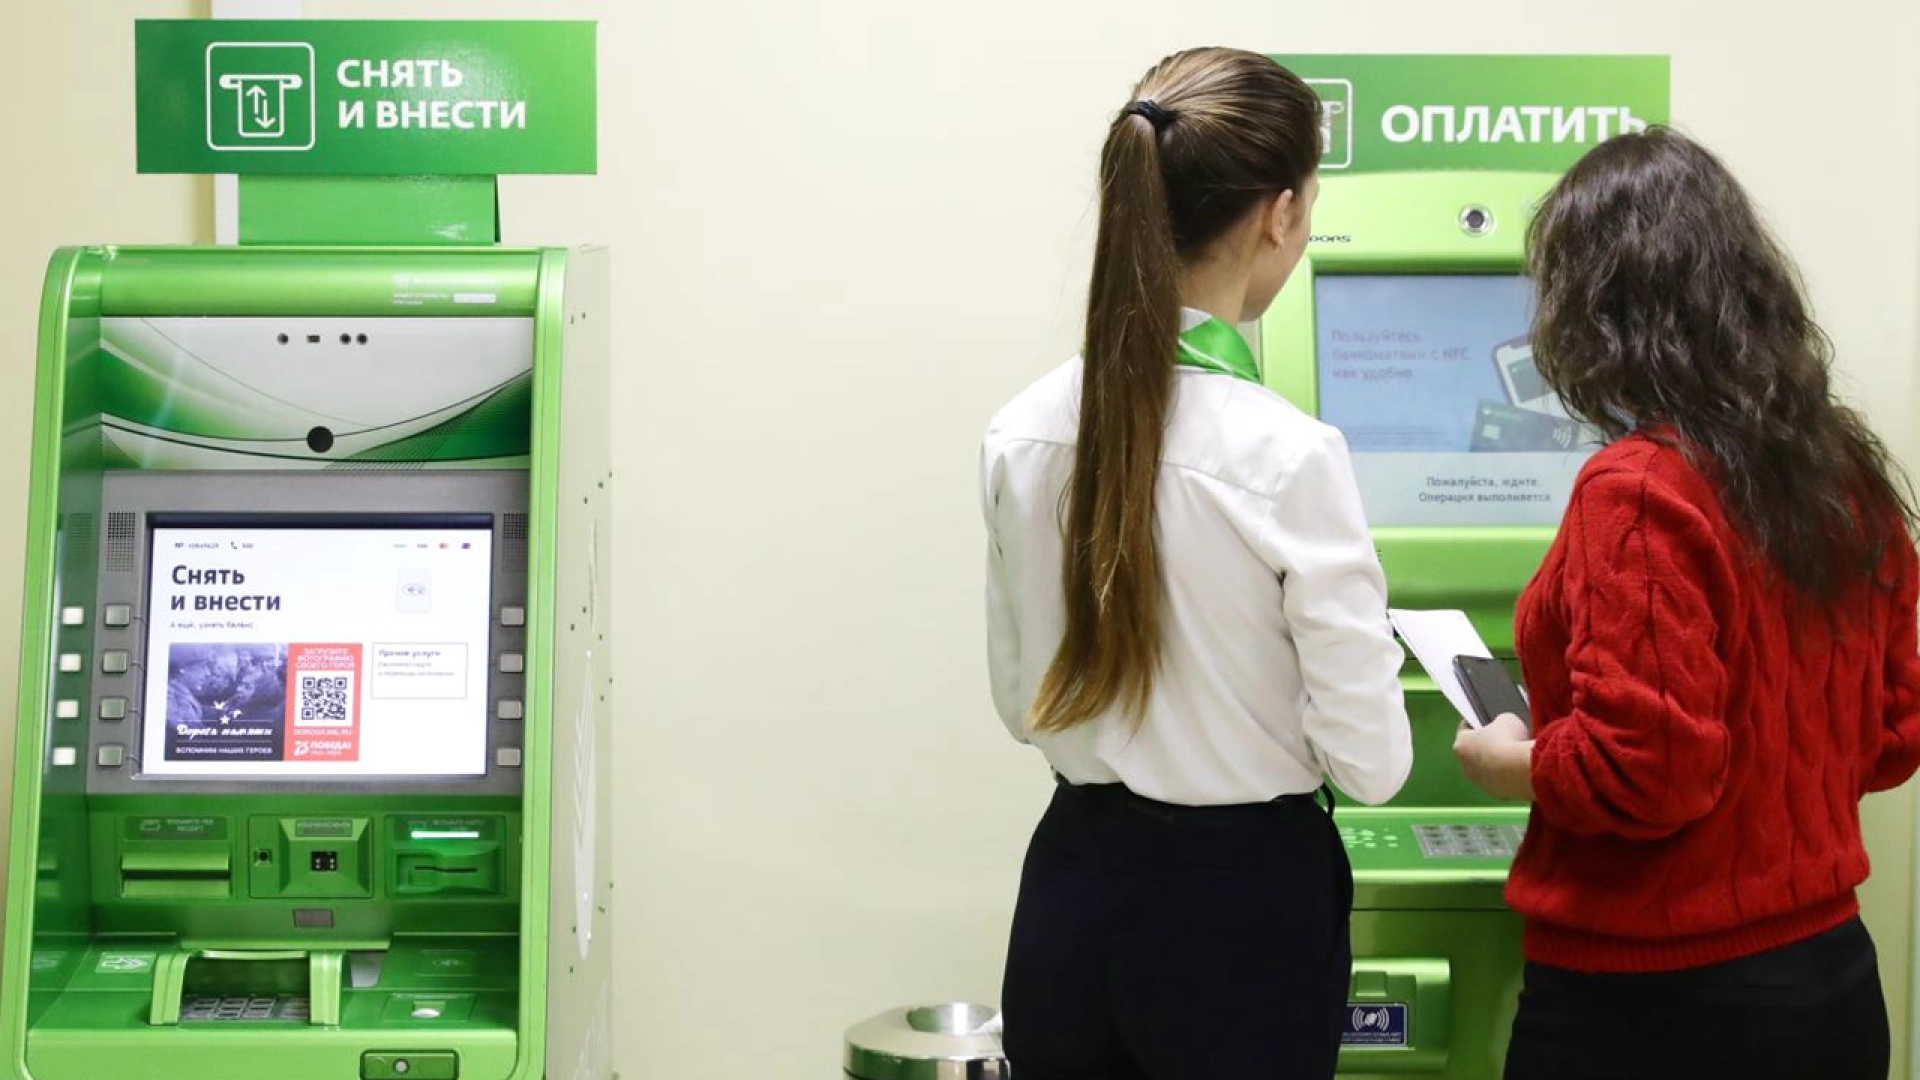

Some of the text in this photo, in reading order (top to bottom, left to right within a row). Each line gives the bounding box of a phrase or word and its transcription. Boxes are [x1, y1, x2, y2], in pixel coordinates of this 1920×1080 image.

[336, 59, 463, 88] СНЯТЬ
[338, 100, 526, 129] И ВНЕСТИ
[1381, 105, 1648, 142] ОПЛАТИТЬ
[1418, 491, 1551, 503] Операция выполняется
[171, 564, 245, 585] Снять
[171, 595, 281, 611] и внести
